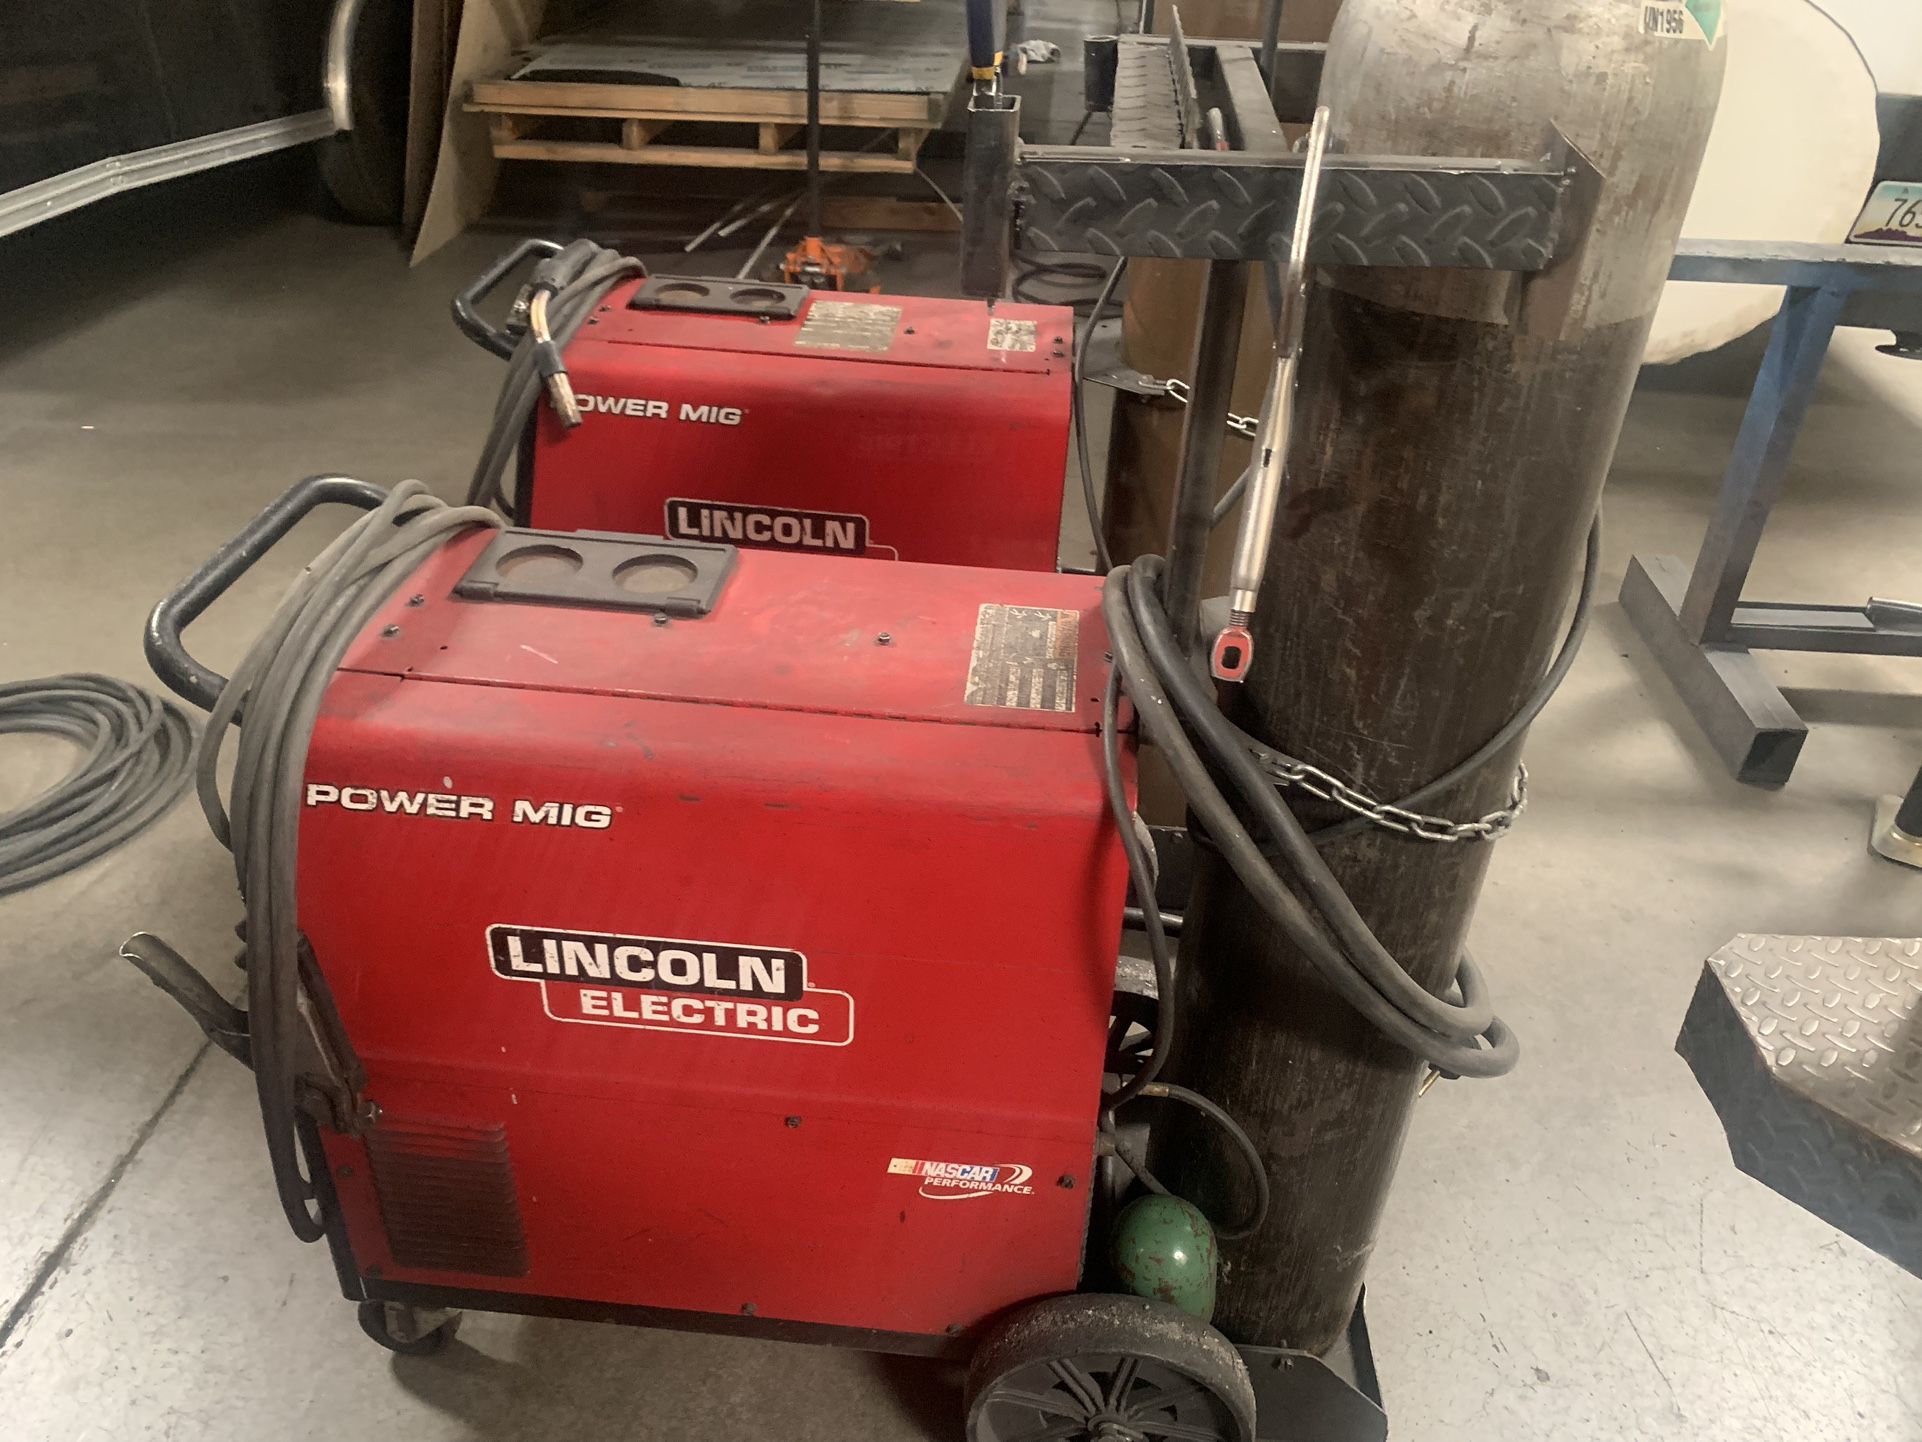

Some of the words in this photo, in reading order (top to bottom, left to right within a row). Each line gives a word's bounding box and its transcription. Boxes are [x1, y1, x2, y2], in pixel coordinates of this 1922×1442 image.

[1644, 6, 1684, 34] UN1956
[1885, 198, 1922, 229] 76
[553, 394, 669, 419] OWER
[679, 403, 742, 425] MIG
[677, 506, 855, 549] LINCOLN
[306, 783, 495, 820] POWER
[511, 799, 613, 829] MIG
[507, 935, 786, 994] LINCOLN
[580, 989, 820, 1034] ELECTRIC
[922, 1161, 994, 1181] NASCAR
[924, 1177, 1033, 1195] PERFORMANCE
